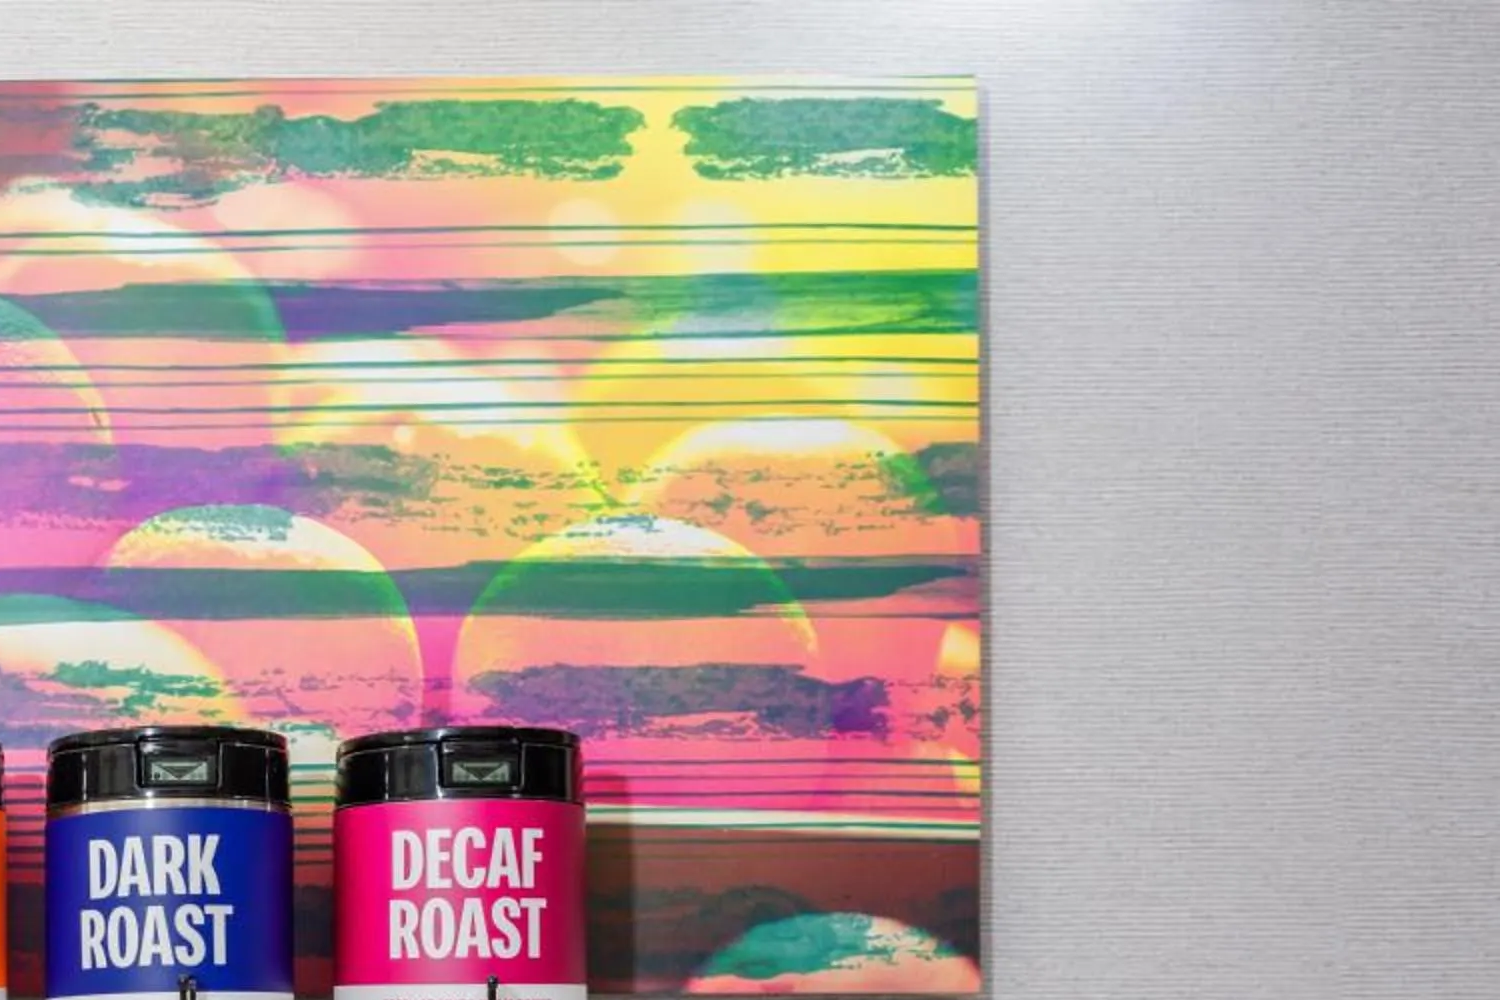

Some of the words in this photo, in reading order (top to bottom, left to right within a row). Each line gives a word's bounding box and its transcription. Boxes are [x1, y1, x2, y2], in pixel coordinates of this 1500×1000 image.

[89, 834, 221, 900] DARK
[392, 827, 544, 889] DECAF
[80, 904, 234, 970] ROAST
[389, 896, 547, 959] ROAST
